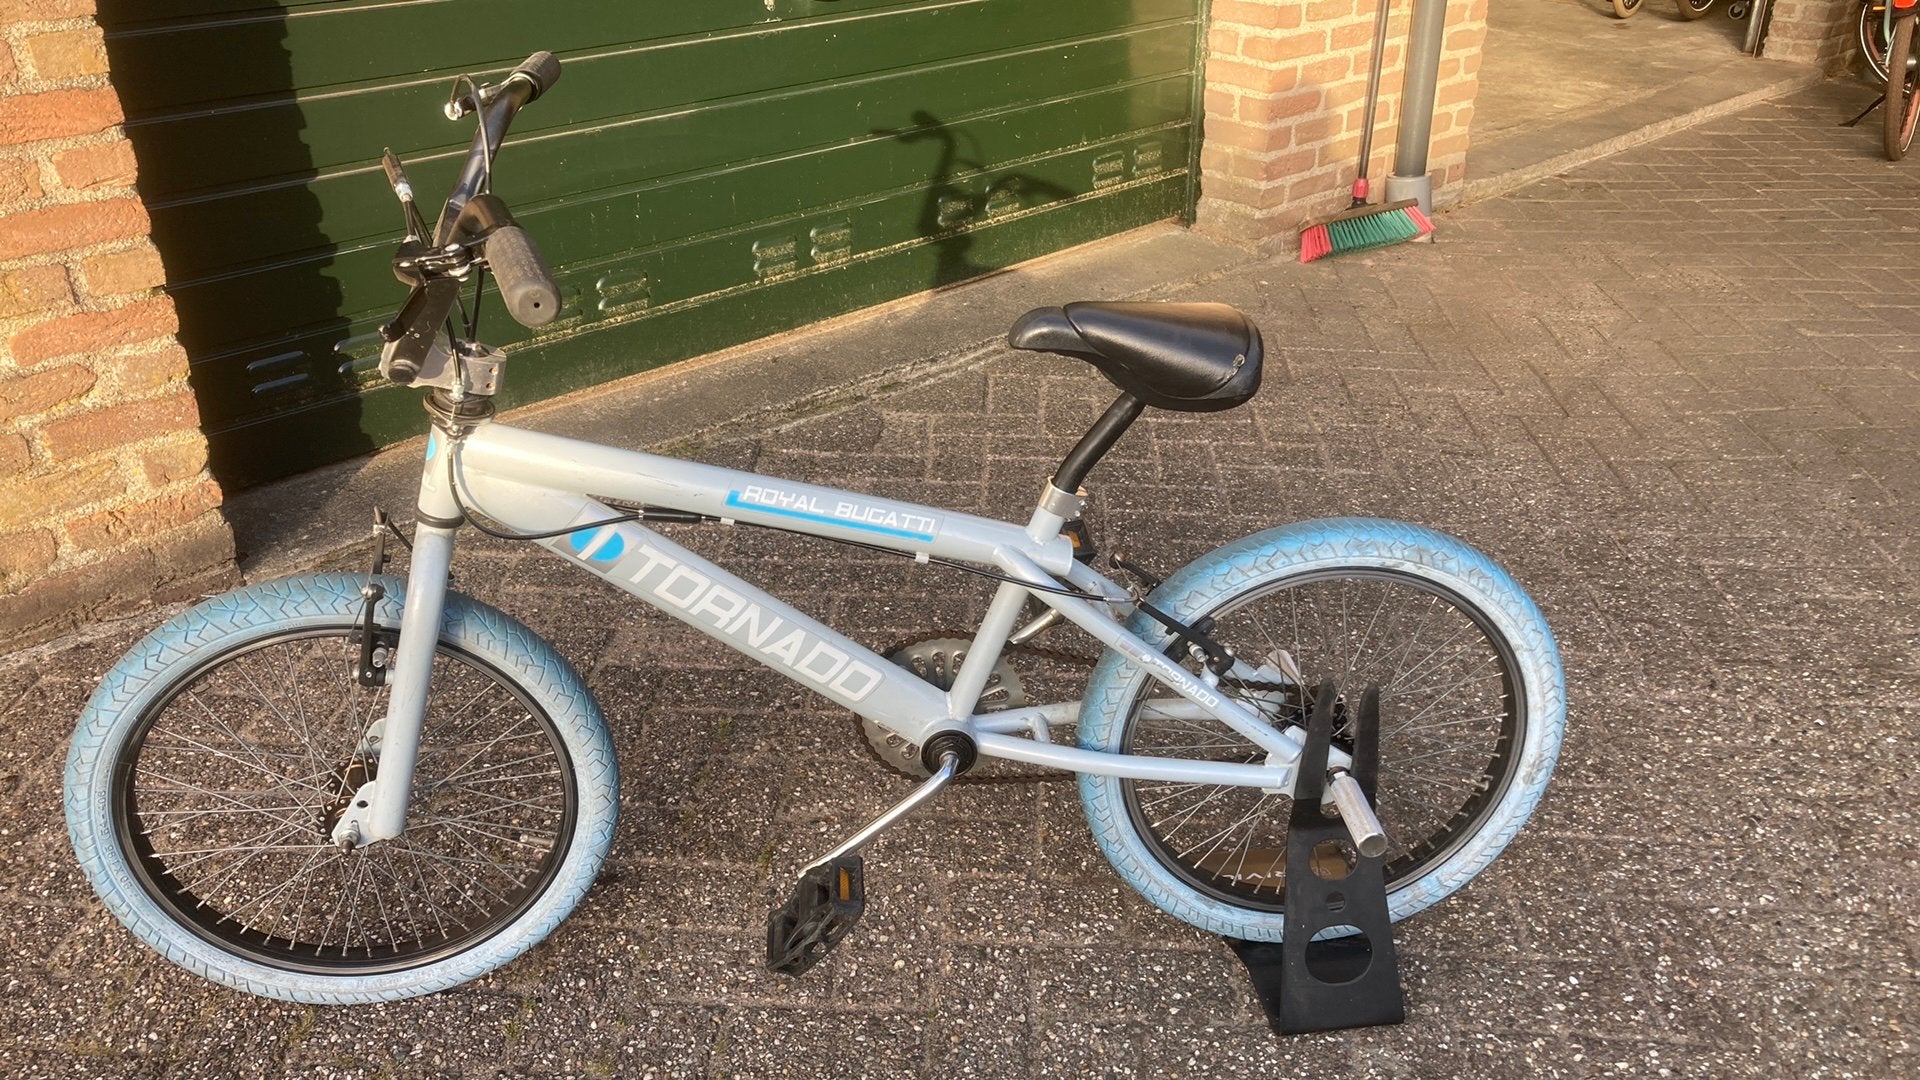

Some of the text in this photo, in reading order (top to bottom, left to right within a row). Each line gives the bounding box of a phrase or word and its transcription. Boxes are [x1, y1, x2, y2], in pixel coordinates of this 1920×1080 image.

[741, 484, 936, 534] ROYAL BUGATTI
[629, 543, 886, 702] TORNADO
